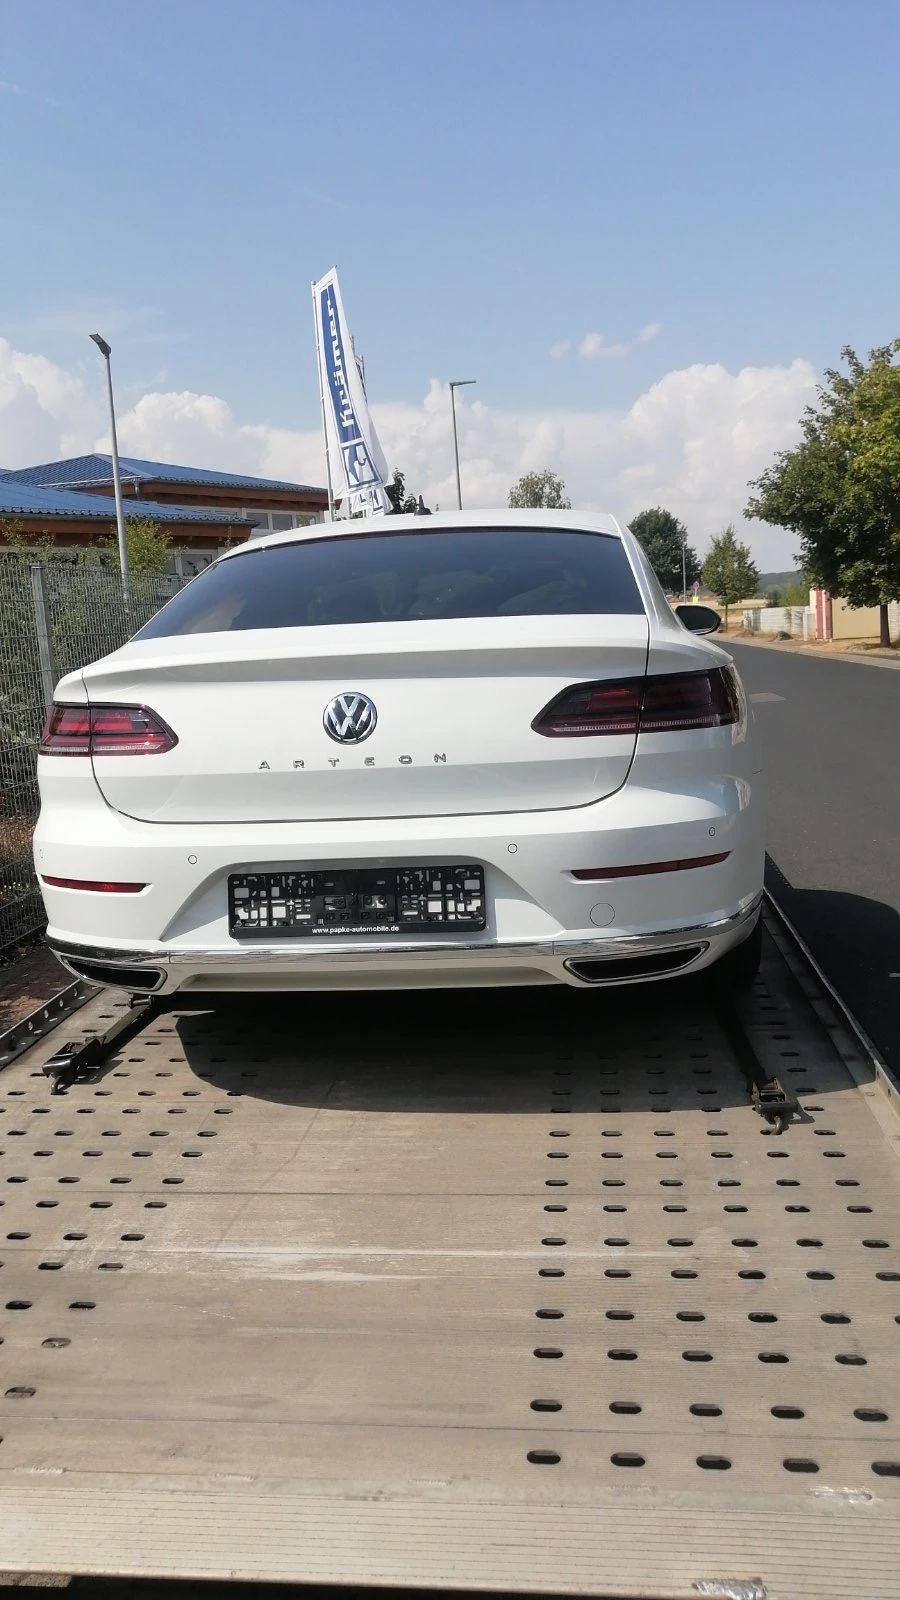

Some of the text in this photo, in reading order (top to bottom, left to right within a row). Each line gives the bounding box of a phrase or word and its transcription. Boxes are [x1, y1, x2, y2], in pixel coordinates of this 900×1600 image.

[324, 693, 376, 744] VW
[258, 753, 447, 770] ARTEON
[311, 925, 400, 934] www.papke-automobile.de
